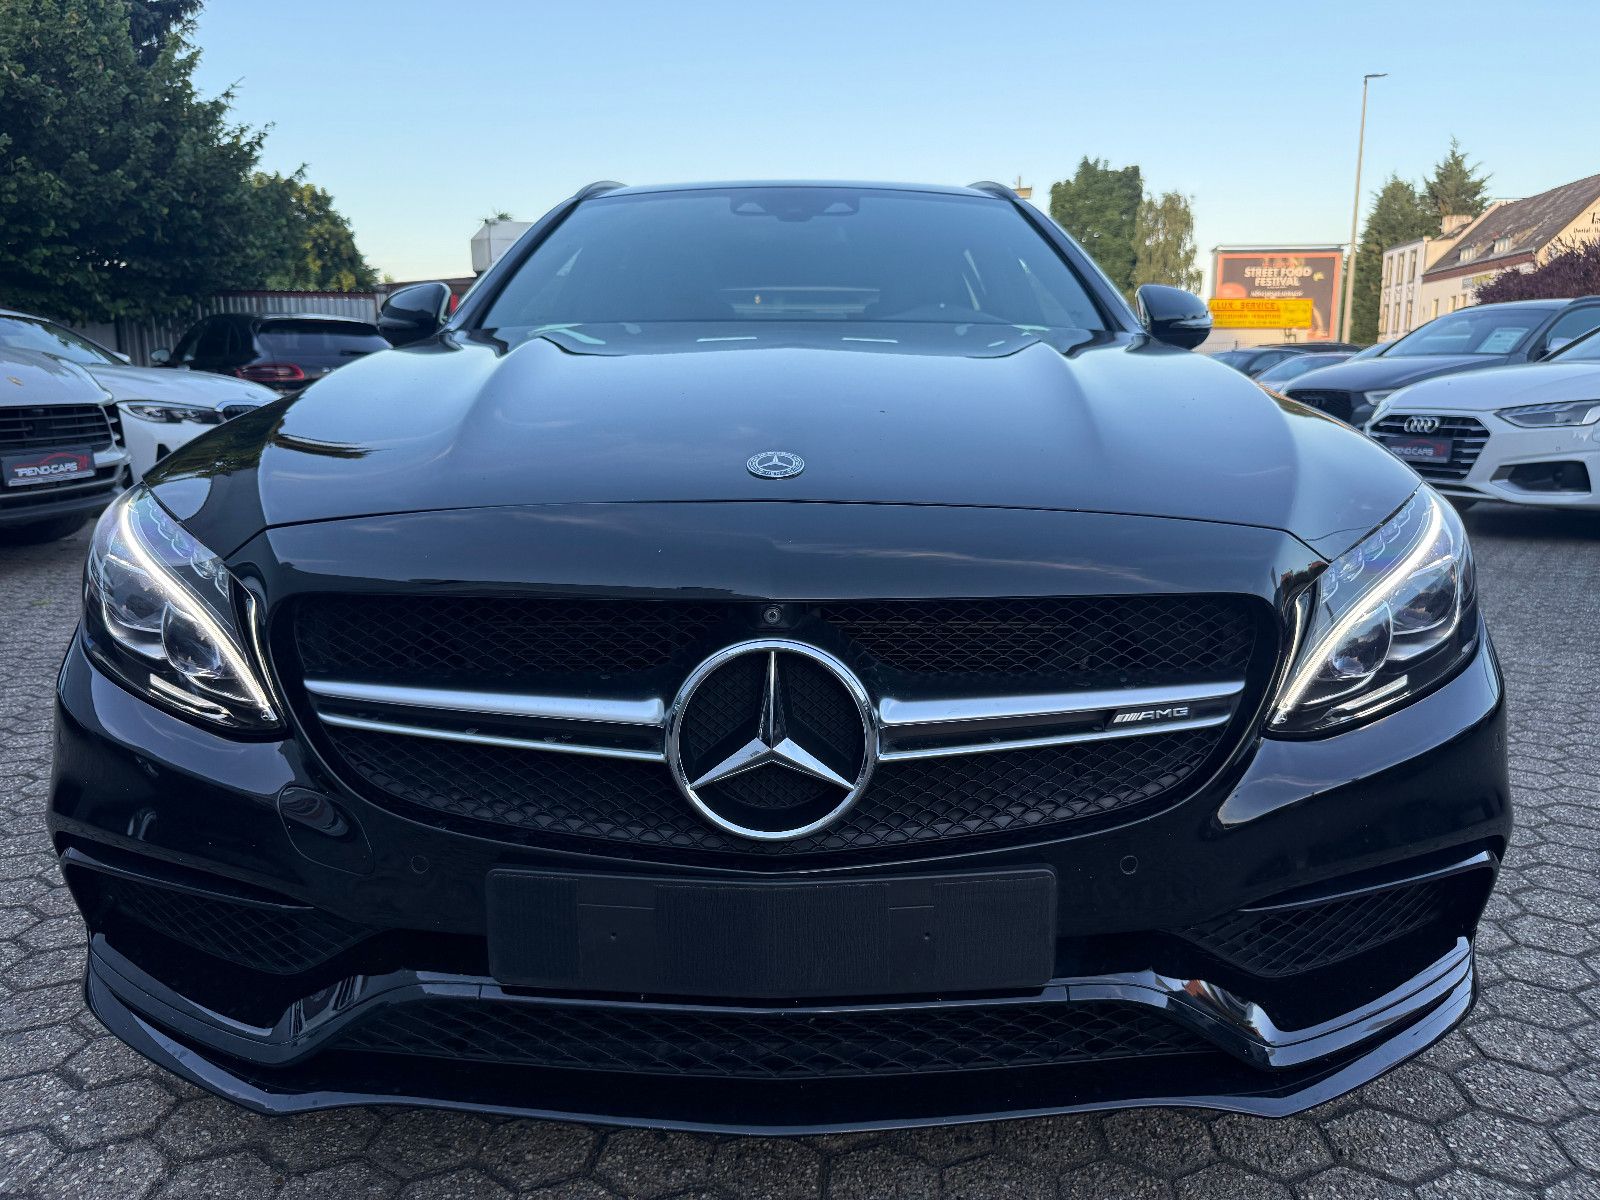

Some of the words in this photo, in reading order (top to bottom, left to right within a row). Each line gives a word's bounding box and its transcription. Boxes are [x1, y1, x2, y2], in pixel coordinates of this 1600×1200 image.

[1244, 266, 1279, 278] STREET
[1280, 265, 1312, 277] FOOD
[1255, 277, 1301, 287] FESTIVAL
[1240, 301, 1276, 310] SERVICE
[1138, 706, 1190, 721] AMG
